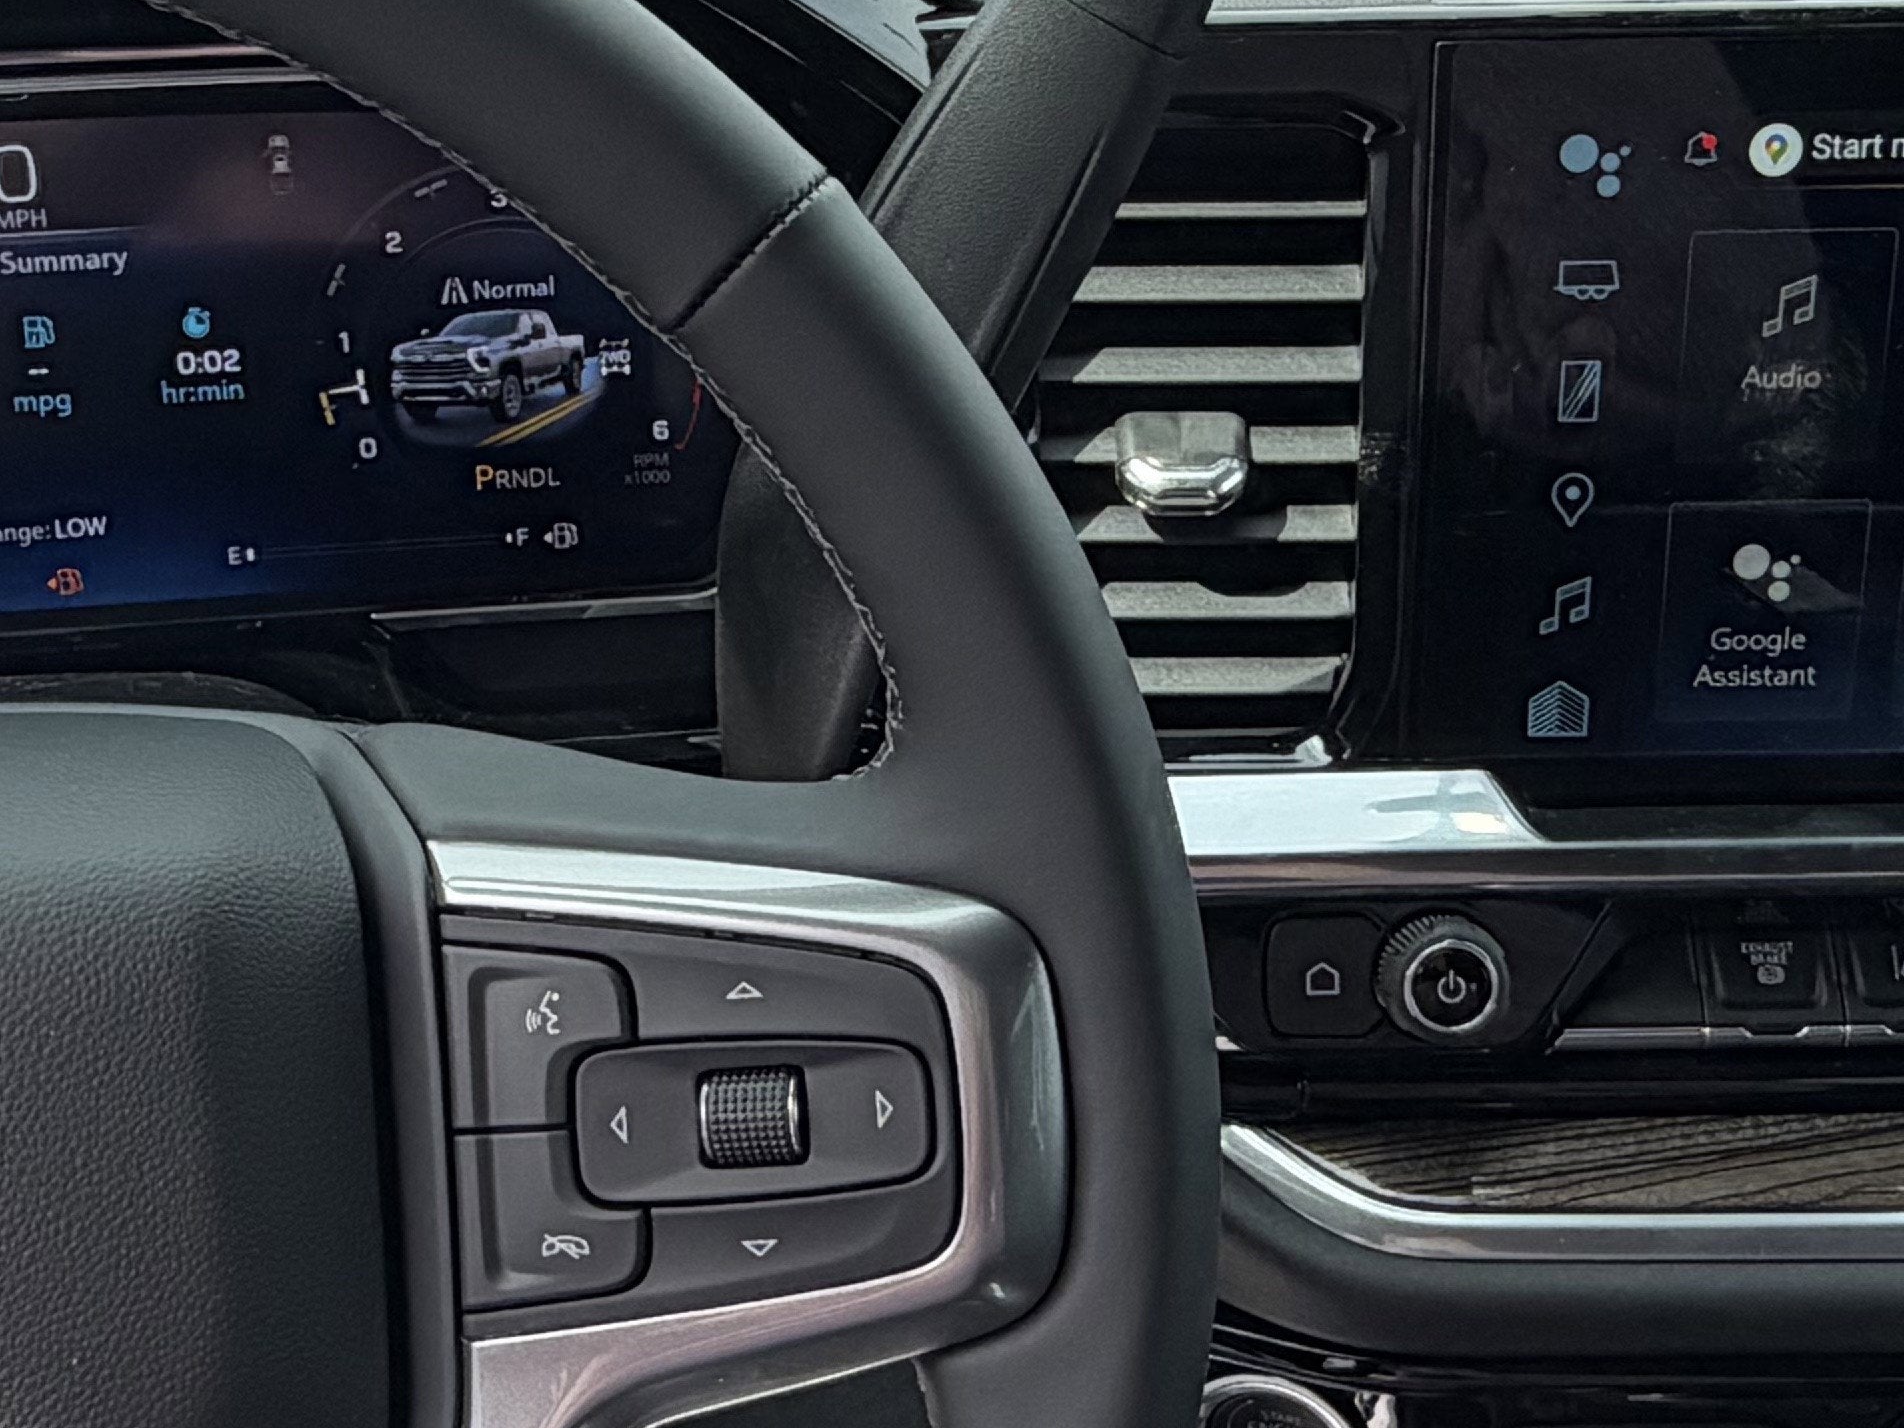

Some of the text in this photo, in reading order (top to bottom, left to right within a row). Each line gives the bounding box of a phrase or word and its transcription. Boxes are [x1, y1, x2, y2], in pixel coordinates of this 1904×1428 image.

[1812, 132, 1884, 160] Start
[384, 231, 404, 254] 2
[0, 250, 128, 275] Summary
[472, 275, 555, 300] Normal
[338, 332, 350, 354] 1
[175, 348, 242, 375] 0:02
[1741, 365, 1823, 390] Audio
[160, 380, 245, 404] hr:min
[13, 393, 73, 418] mpg
[652, 420, 670, 441] 6
[358, 438, 378, 459] 0
[633, 453, 670, 468] RPM
[475, 464, 561, 491] PRNDL
[624, 469, 671, 485] x1000
[55, 517, 108, 539] LOW
[516, 528, 530, 547] F
[227, 547, 242, 565] E
[1710, 626, 1806, 658] Google
[1693, 664, 1816, 687] Assistant
